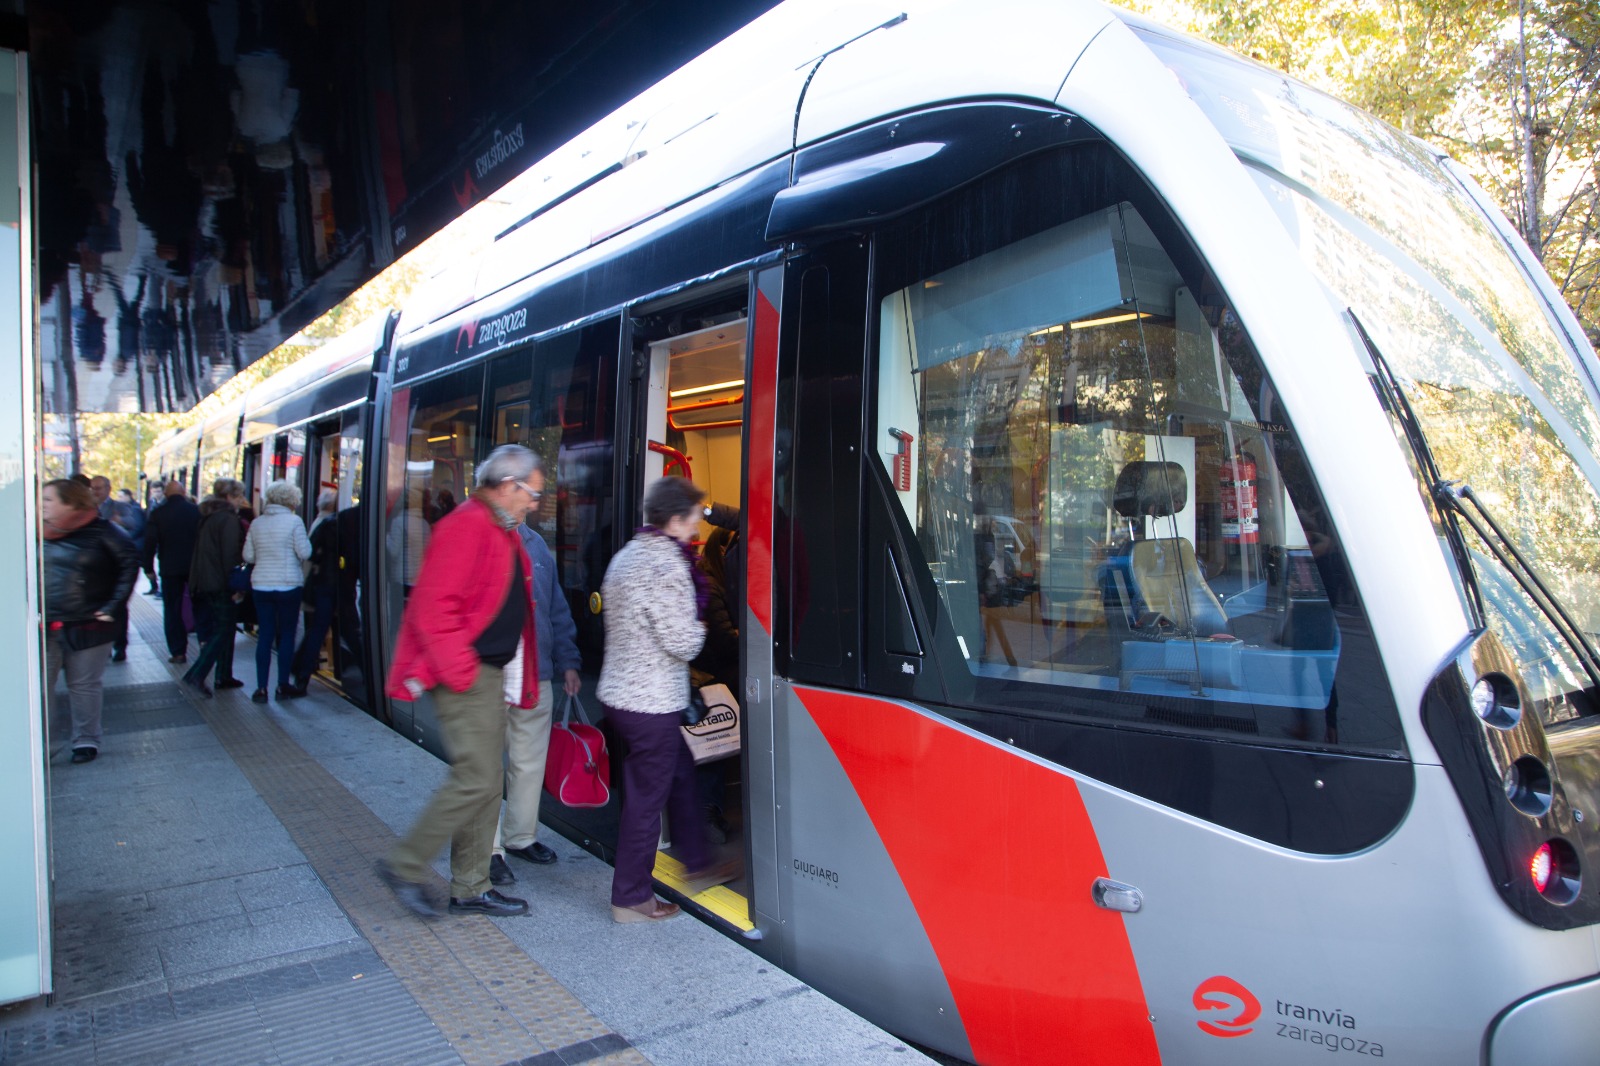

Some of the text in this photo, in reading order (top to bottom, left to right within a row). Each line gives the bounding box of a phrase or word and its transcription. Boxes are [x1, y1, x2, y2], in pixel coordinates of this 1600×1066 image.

[478, 308, 527, 346] zaragoza
[689, 711, 734, 730] errano
[793, 858, 839, 883] GIUGIARO
[1276, 999, 1356, 1030] tranvía
[1276, 1021, 1384, 1058] zaragoza
